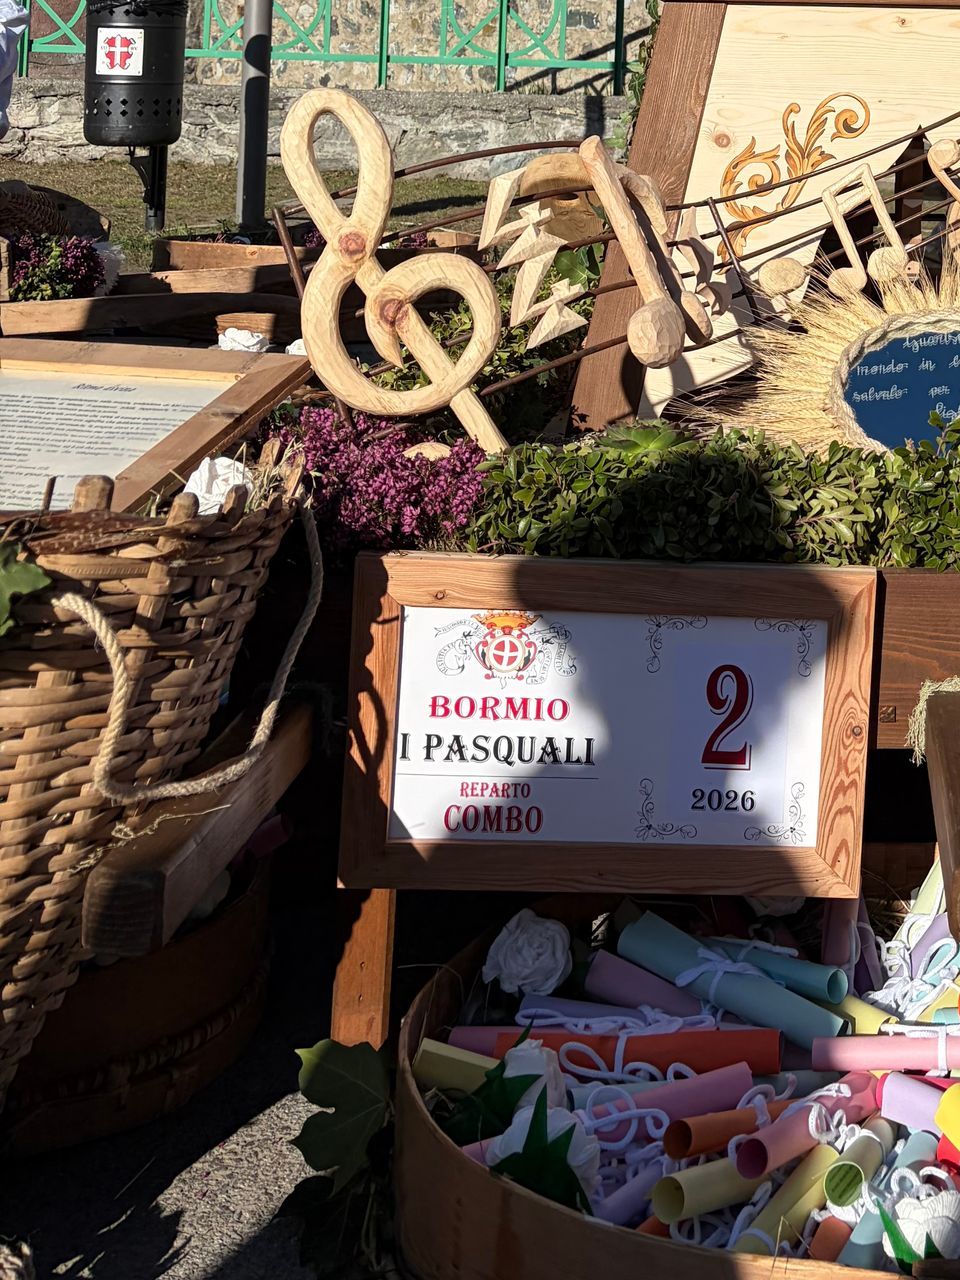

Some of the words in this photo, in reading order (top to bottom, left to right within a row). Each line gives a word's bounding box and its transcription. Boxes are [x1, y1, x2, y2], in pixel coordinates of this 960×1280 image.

[918, 357, 936, 371] in
[928, 384, 951, 398] per
[428, 695, 571, 721] BORMIO
[701, 664, 754, 771] 2
[399, 733, 411, 761] I
[423, 733, 596, 767] PASQUALI
[460, 781, 531, 799] REPARTO
[690, 788, 756, 811] 2026
[443, 804, 544, 834] COMBO
